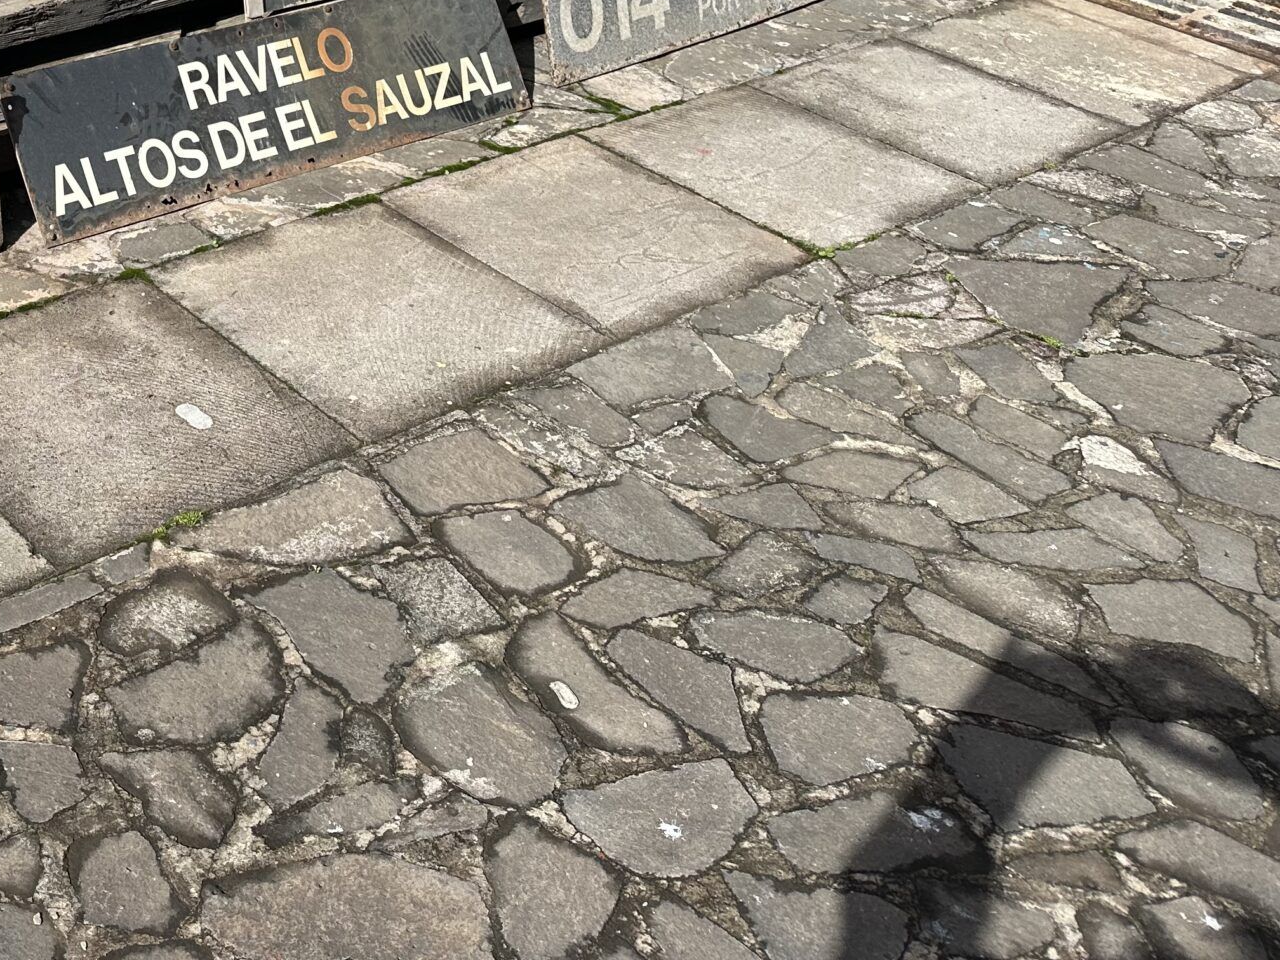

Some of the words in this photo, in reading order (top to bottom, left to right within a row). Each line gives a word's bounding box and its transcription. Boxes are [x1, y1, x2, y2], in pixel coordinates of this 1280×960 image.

[178, 27, 354, 110] RAVELO
[54, 129, 209, 217] ALTOS
[208, 114, 278, 171] DE
[276, 99, 337, 152] EL
[340, 51, 512, 133] SAUZAL
